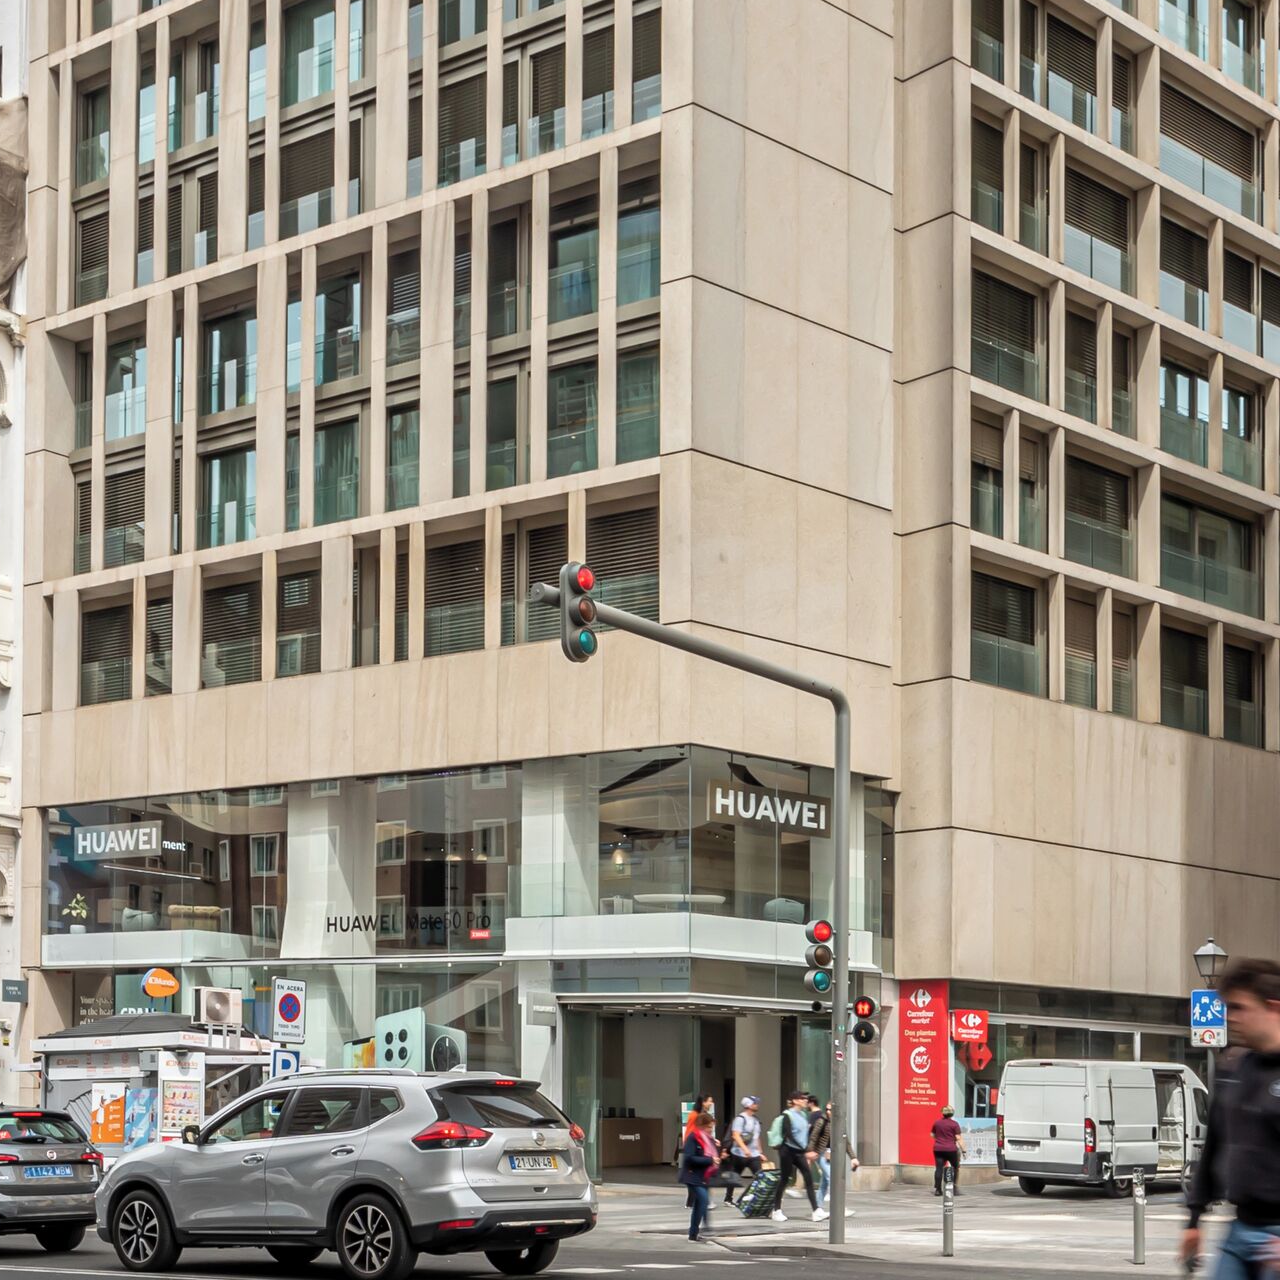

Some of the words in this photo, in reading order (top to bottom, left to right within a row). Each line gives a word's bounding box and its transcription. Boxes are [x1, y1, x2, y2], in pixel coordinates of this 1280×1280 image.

[716, 787, 826, 830] HUAWEI
[77, 827, 157, 855] HUAWEI
[327, 914, 397, 933] HUAWEI
[466, 912, 491, 929] Pro
[80, 996, 95, 1004] Your
[80, 1008, 86, 1016] in
[87, 1007, 98, 1016] the
[99, 1007, 114, 1016] hear
[31, 1167, 54, 1177] 1142
